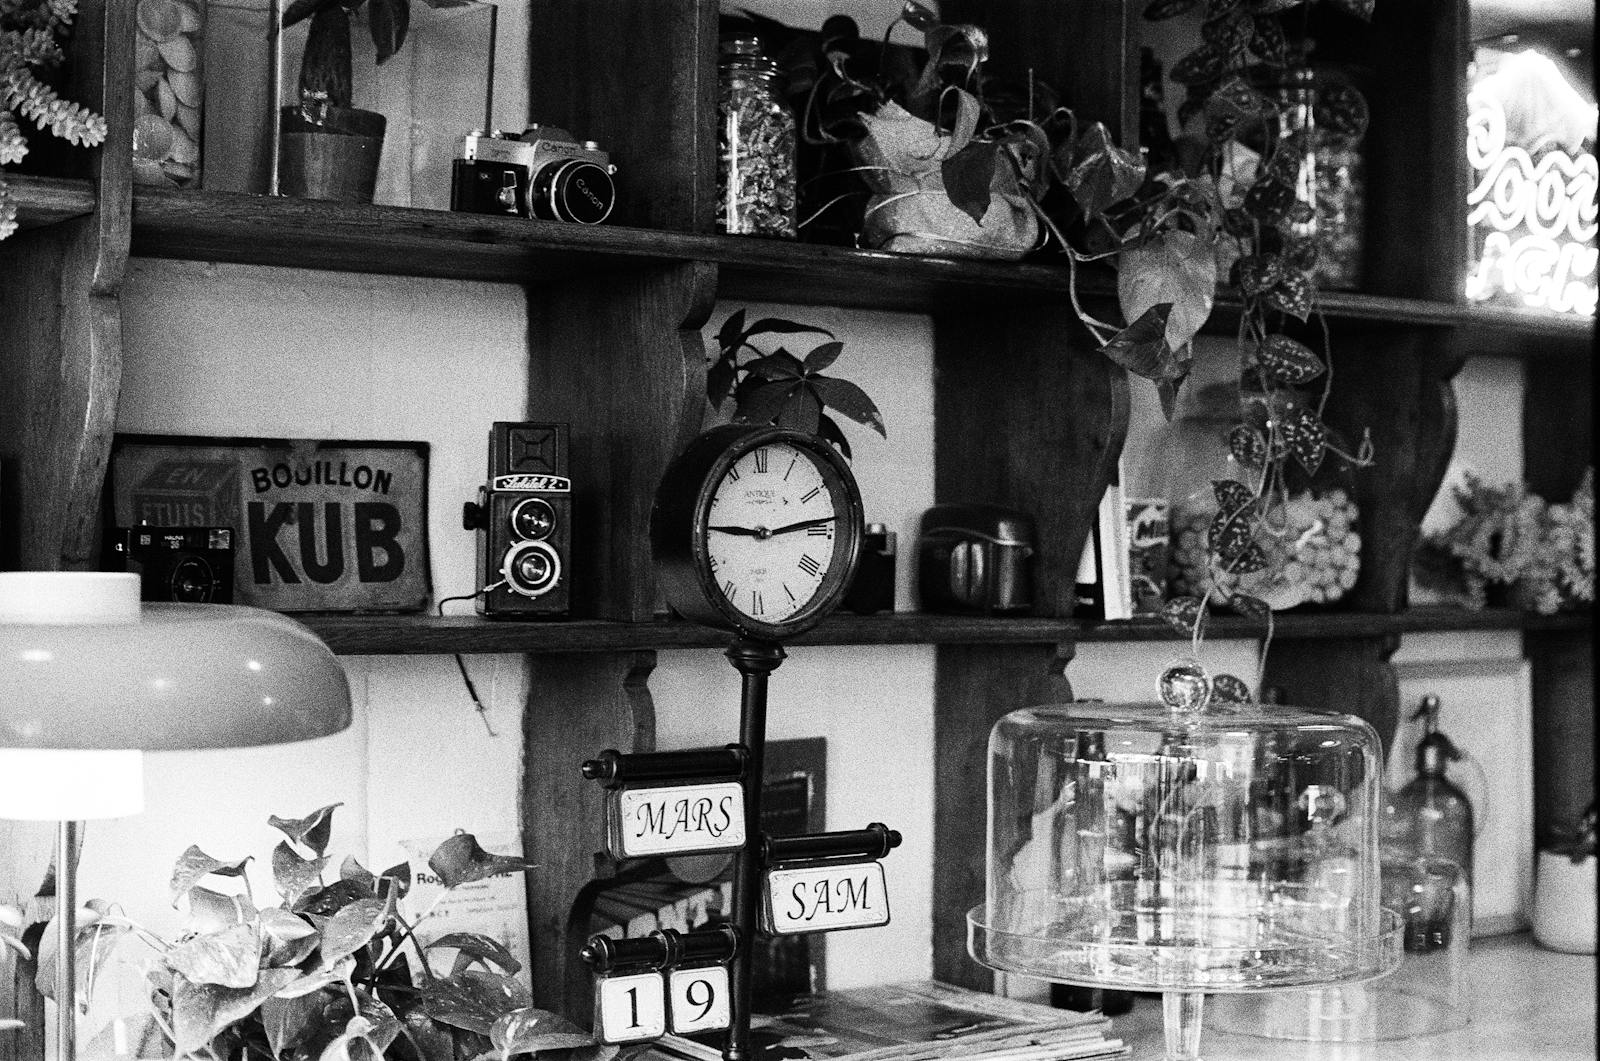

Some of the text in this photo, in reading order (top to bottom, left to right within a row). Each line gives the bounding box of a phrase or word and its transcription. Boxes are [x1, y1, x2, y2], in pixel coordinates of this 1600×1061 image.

[542, 141, 577, 155] Canon
[576, 178, 604, 210] Canon
[251, 461, 393, 495] BOUILLON
[502, 476, 558, 489] Lubitel 2
[248, 502, 405, 584] KUB
[636, 796, 733, 839] MARS
[787, 876, 872, 921] SAM
